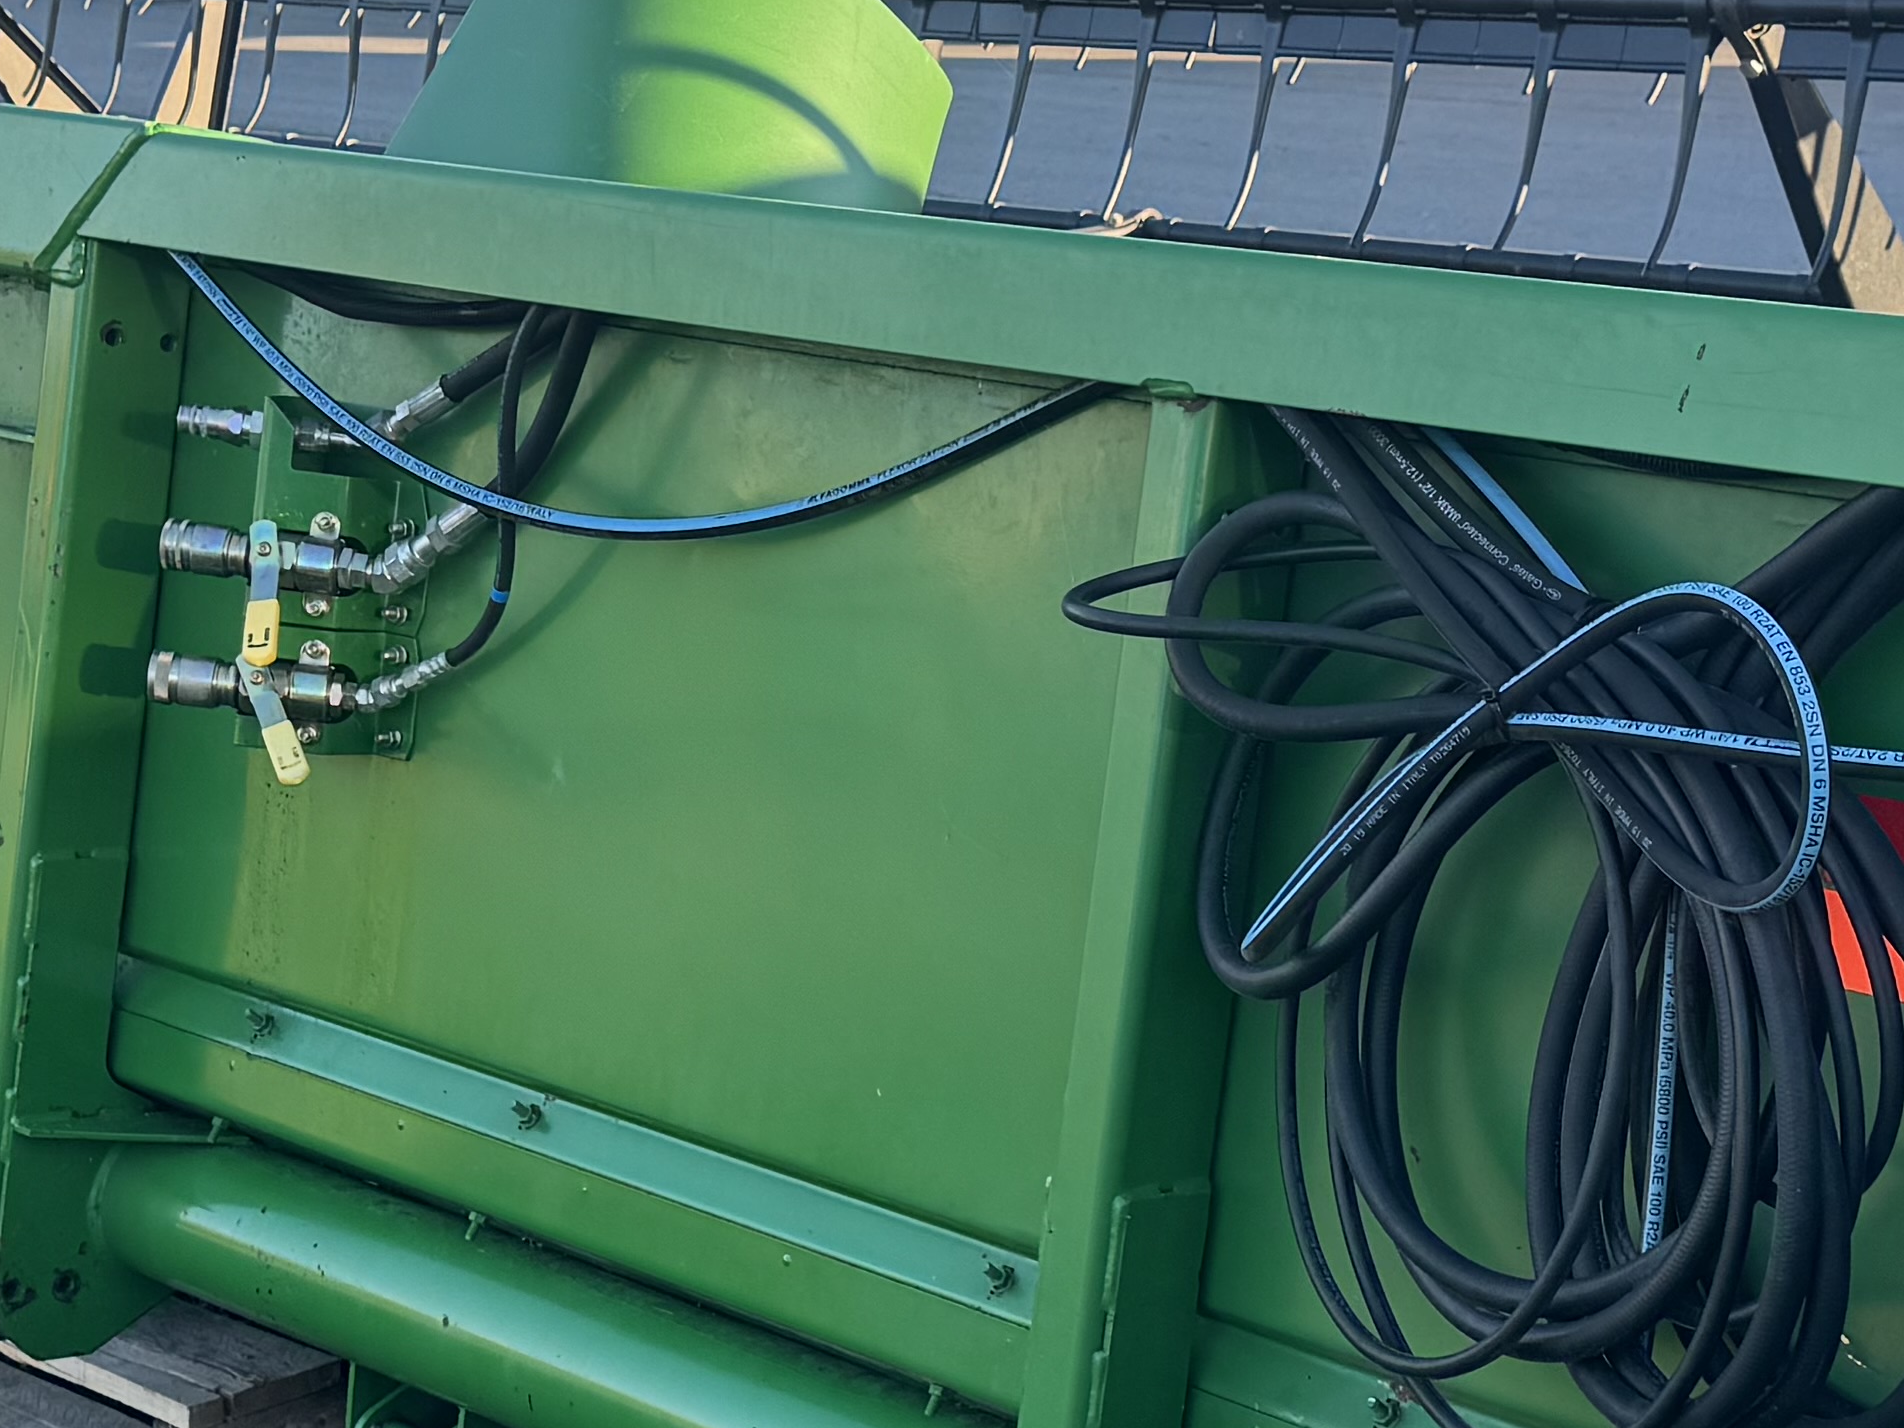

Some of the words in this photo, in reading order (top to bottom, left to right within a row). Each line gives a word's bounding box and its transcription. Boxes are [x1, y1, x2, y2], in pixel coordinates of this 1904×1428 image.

[1462, 521, 1510, 567] Connected
[1511, 562, 1544, 590] Gates
[1706, 582, 1734, 599] SAE
[1732, 593, 1755, 611] 100
[1749, 608, 1784, 639] R2AT
[1775, 640, 1798, 664] EN
[1789, 665, 1811, 696] 853
[1802, 699, 1823, 738] 2SN
[1811, 743, 1827, 773] DN
[1831, 746, 1888, 761] 2AT/2S
[1387, 789, 1401, 804] IN
[1813, 778, 1828, 790] 6
[1804, 795, 1828, 849] MSHA
[1664, 972, 1676, 999] WP
[1660, 1036, 1675, 1071] MPa
[1657, 1074, 1673, 1116] (5800
[1651, 1153, 1667, 1188] SAE
[1648, 1190, 1663, 1217] 100
